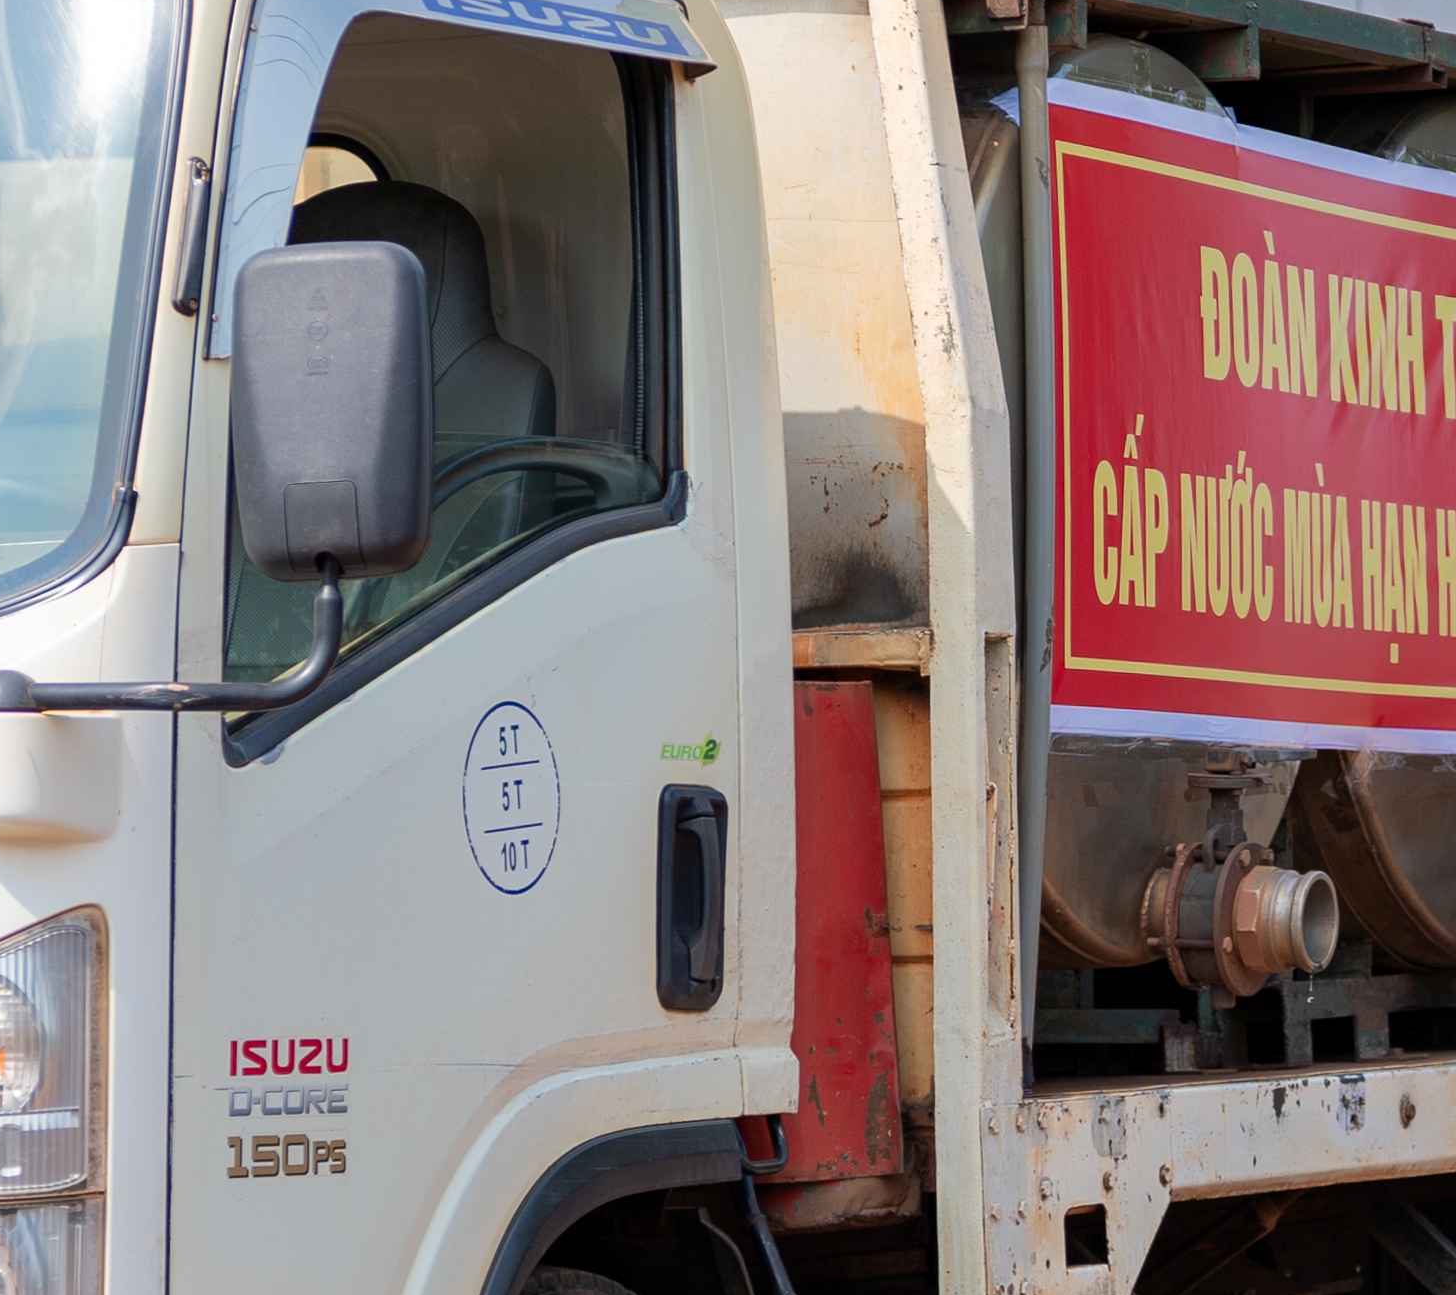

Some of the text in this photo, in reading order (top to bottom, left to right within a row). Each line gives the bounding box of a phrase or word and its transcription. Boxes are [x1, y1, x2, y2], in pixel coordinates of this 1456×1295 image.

[1200, 230, 1317, 398] ĐOÀN
[1328, 273, 1426, 415] KINH
[1093, 414, 1169, 608] CẤP
[1180, 451, 1274, 622] NƯỚC
[1283, 463, 1354, 628] MÙA
[1361, 499, 1429, 664] HẠN
[229, 1085, 349, 1117] D-CORE
[230, 1038, 349, 1077] ISUZU
